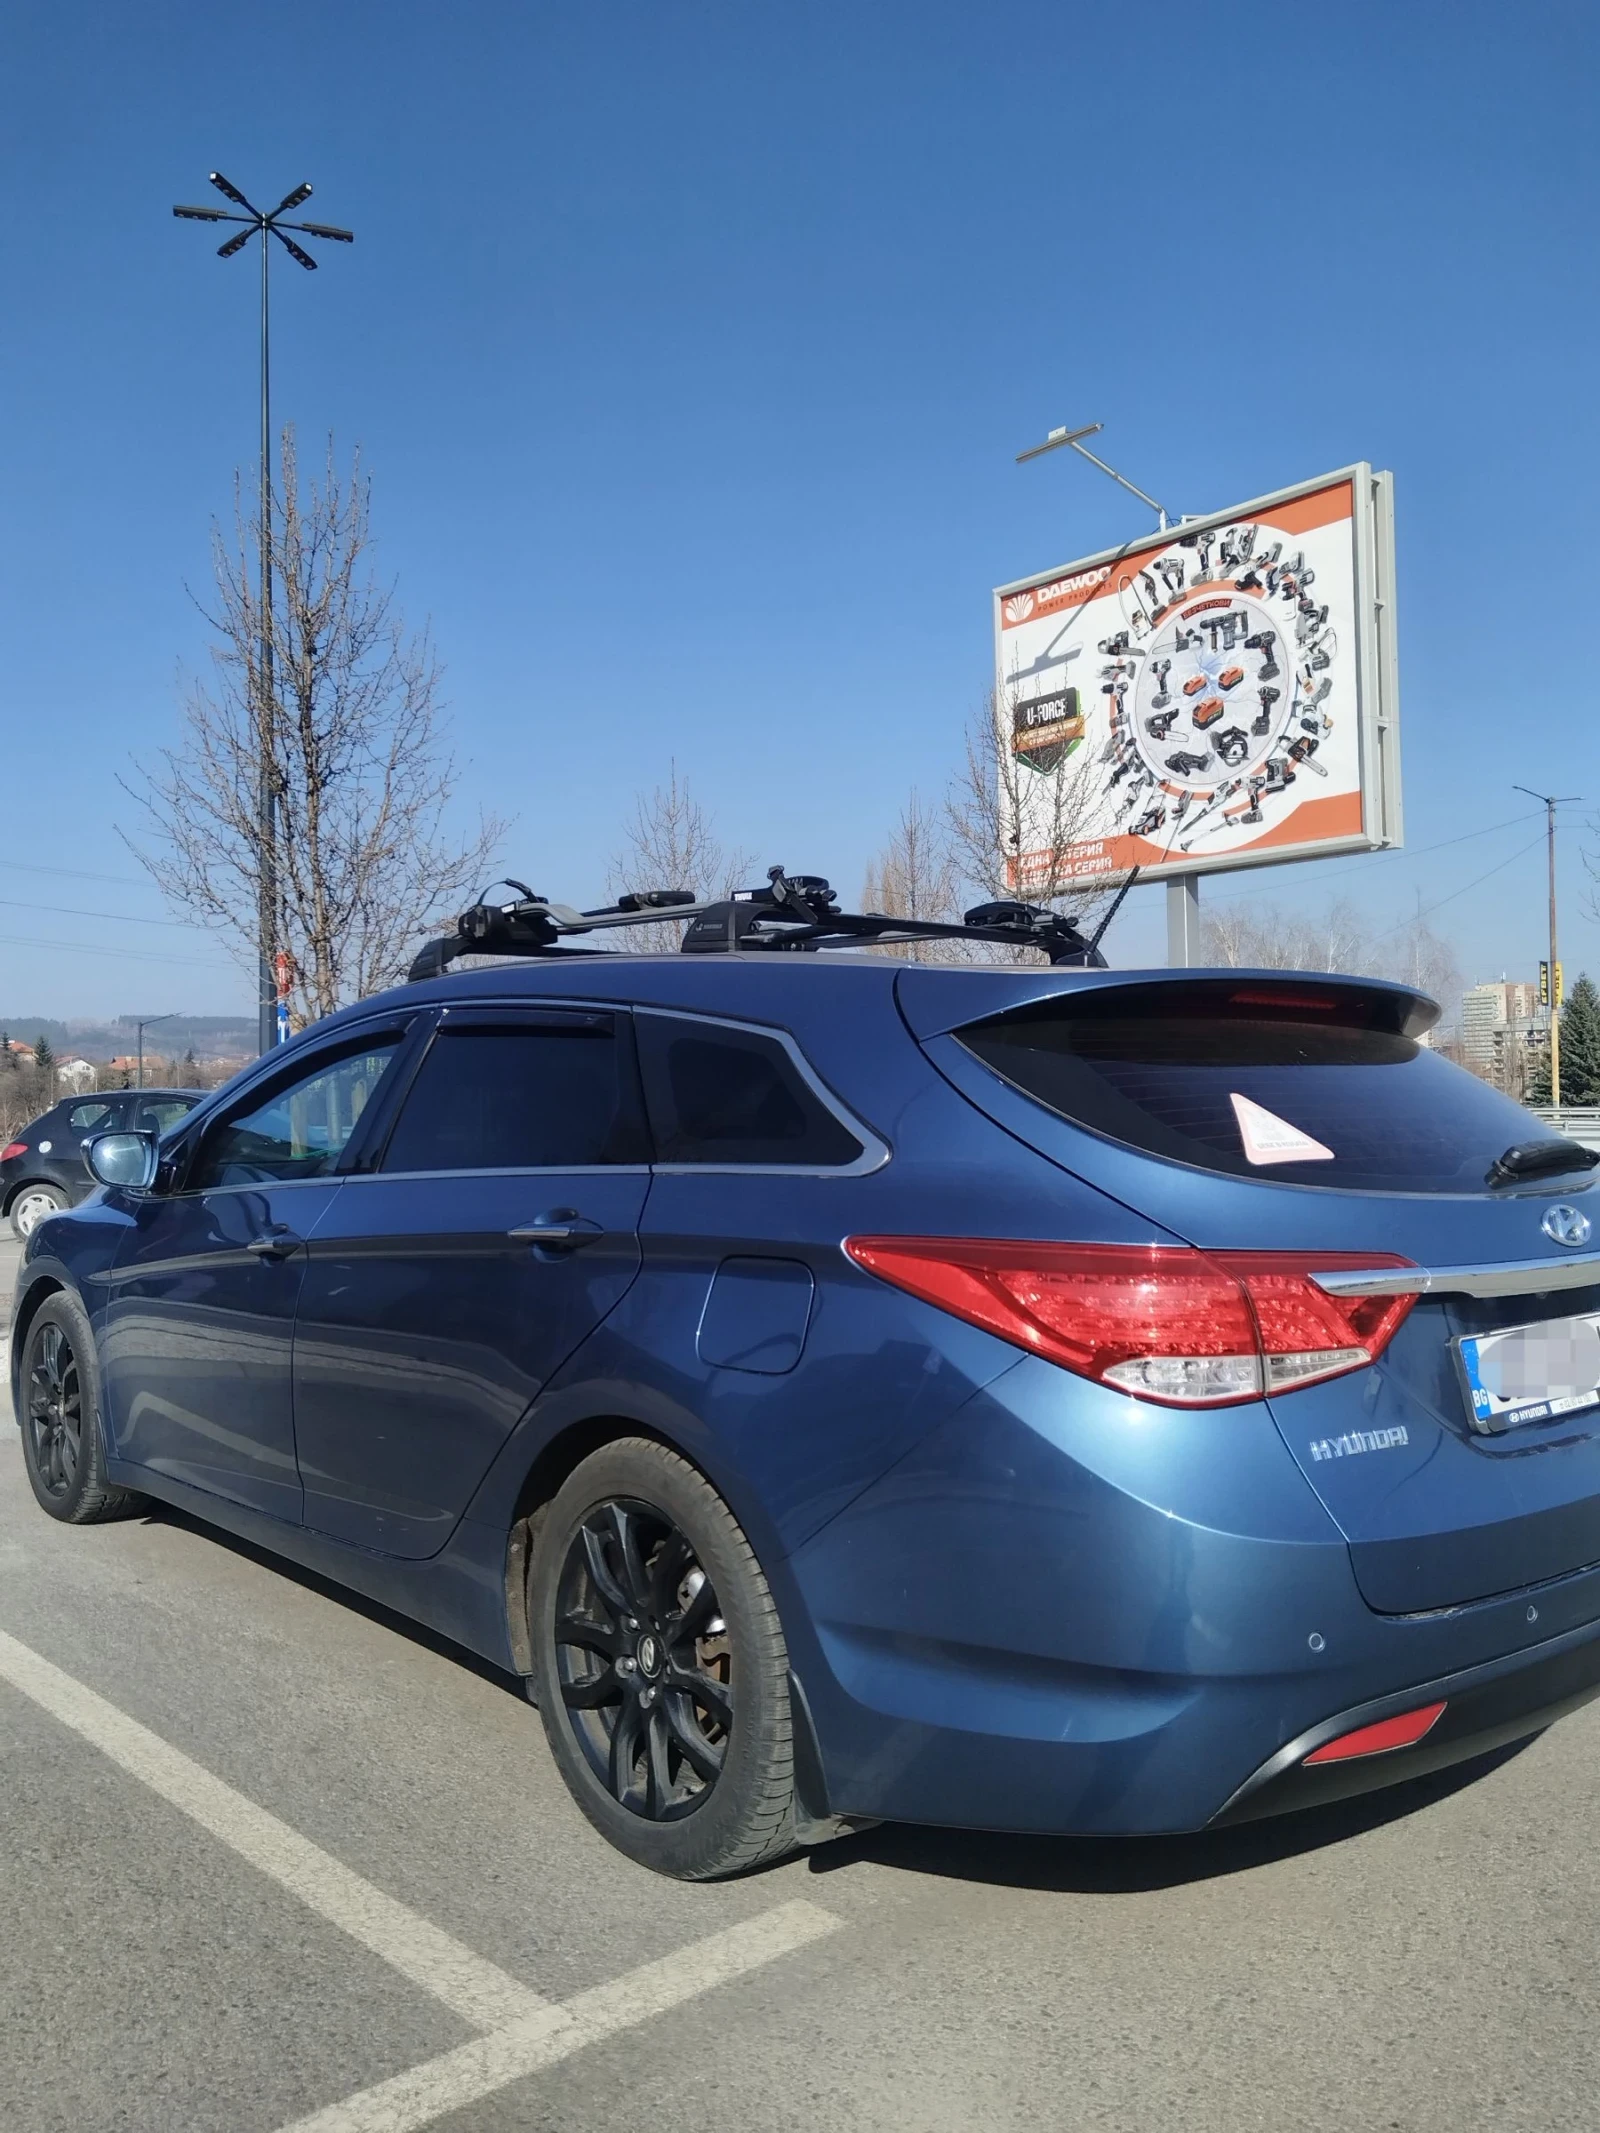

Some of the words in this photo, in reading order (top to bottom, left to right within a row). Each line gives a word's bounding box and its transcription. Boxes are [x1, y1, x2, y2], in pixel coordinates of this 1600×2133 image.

[1037, 566, 1112, 603] DAEWOO
[1038, 597, 1064, 612] POWER
[1068, 582, 1113, 601] PRODTS
[1027, 698, 1067, 726] U-FORCE
[1075, 856, 1113, 875] СЕРИЯ
[1472, 1388, 1488, 1407] BG
[1519, 1405, 1548, 1420] HYUNDAI
[1310, 1425, 1409, 1461] HYUNDAI
